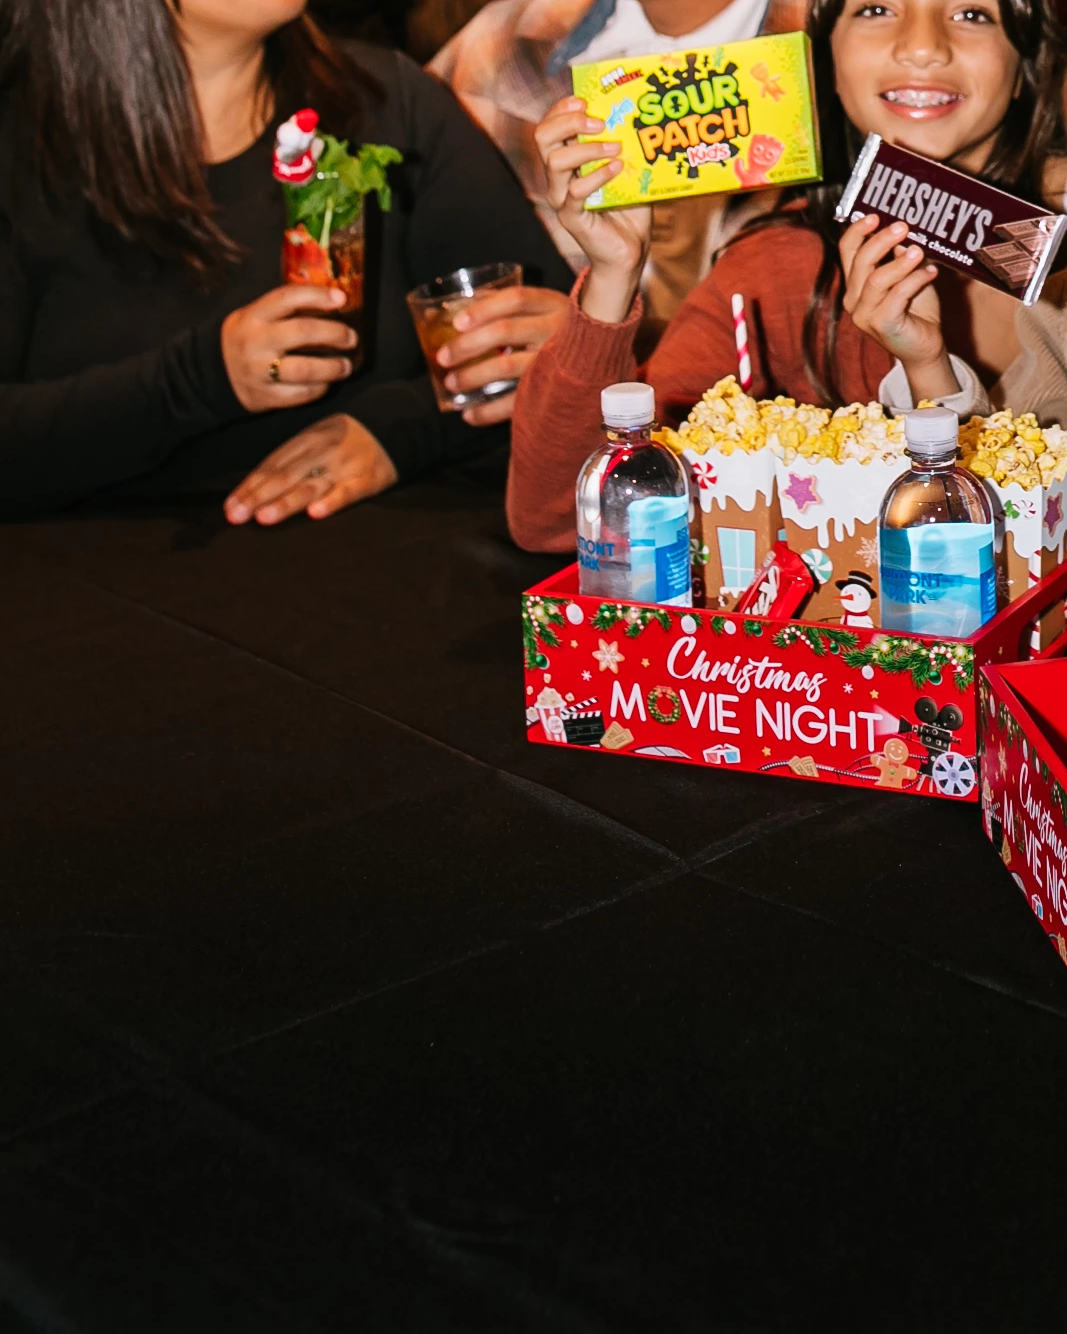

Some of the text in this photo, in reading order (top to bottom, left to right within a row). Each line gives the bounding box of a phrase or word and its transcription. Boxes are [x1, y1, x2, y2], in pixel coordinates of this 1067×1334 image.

[638, 74, 740, 125] SOUR
[637, 105, 751, 161] PATCH
[687, 143, 731, 167] Kids
[861, 163, 993, 253] HERSHEY'S
[927, 239, 975, 267] chocolate
[666, 635, 828, 703] Christmas
[755, 700, 884, 752] NIGHT
